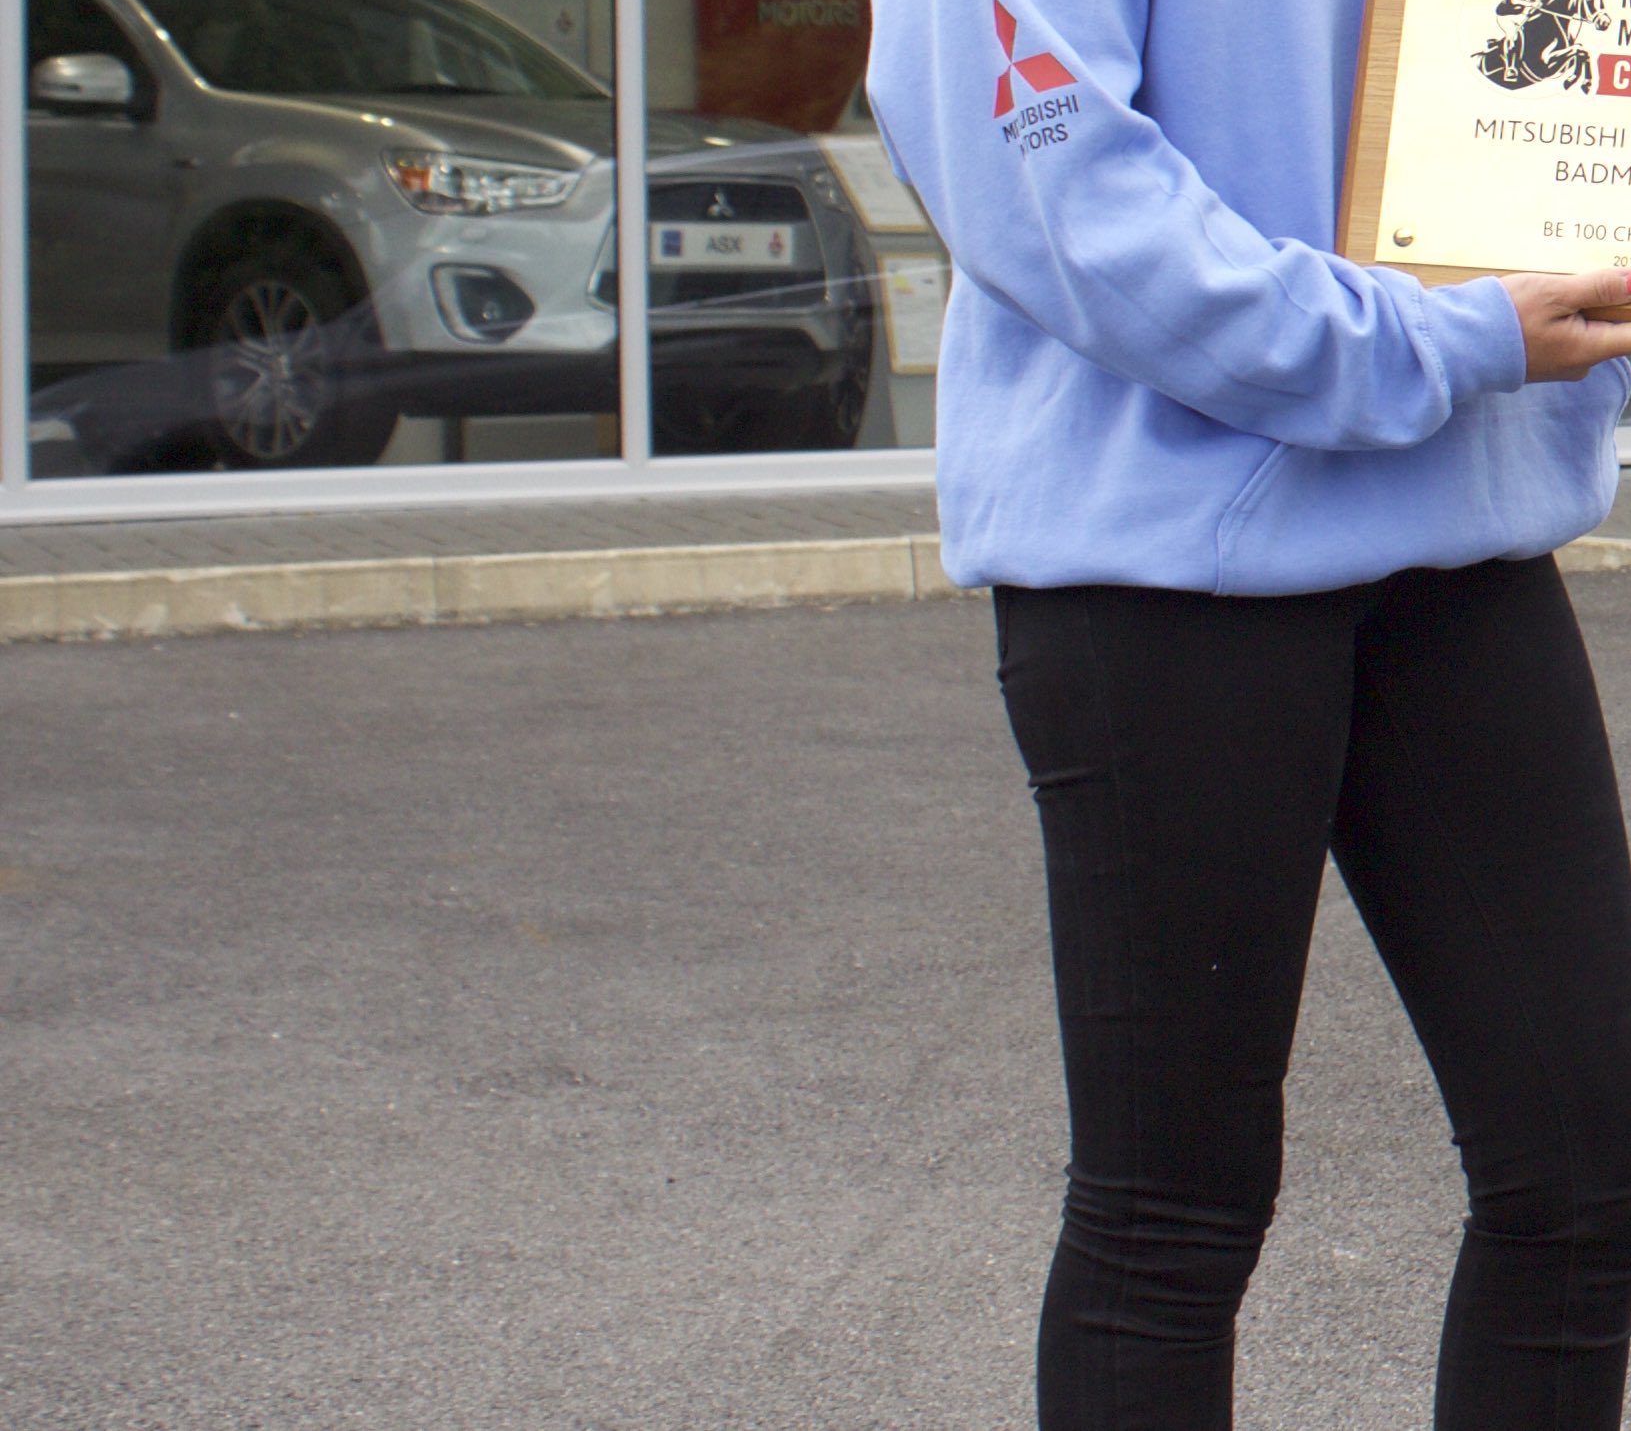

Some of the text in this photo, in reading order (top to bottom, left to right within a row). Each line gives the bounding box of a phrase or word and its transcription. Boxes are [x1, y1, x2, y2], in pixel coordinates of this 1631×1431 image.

[1474, 118, 1626, 149] MITSUBISHI
[1542, 220, 1565, 238] BE
[1574, 223, 1608, 241] 100
[705, 233, 744, 255] ASX
